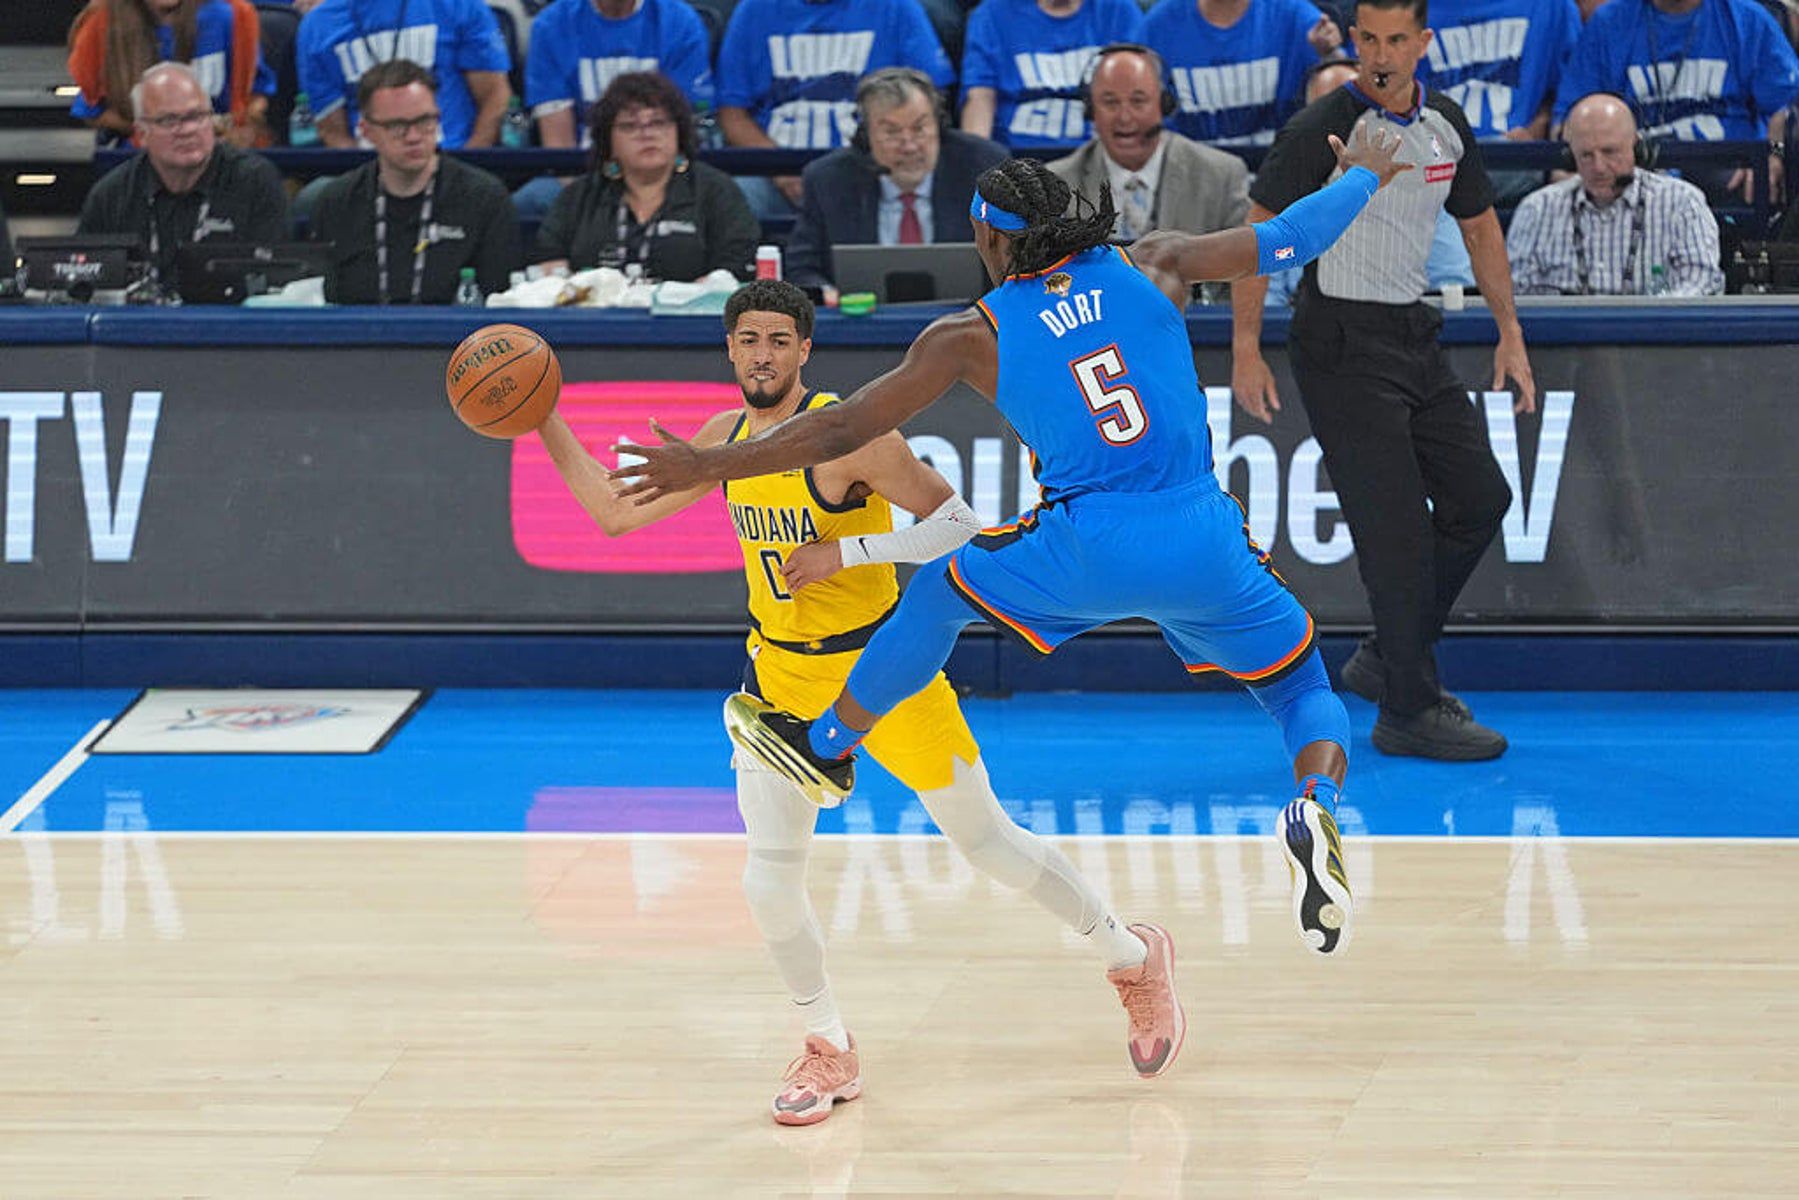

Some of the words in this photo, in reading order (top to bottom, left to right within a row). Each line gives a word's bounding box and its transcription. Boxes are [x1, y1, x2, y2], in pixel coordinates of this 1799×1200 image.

[1039, 289, 1103, 338] DORT
[1068, 343, 1149, 447] 5
[0, 391, 163, 562] TV
[1466, 391, 1576, 562] V
